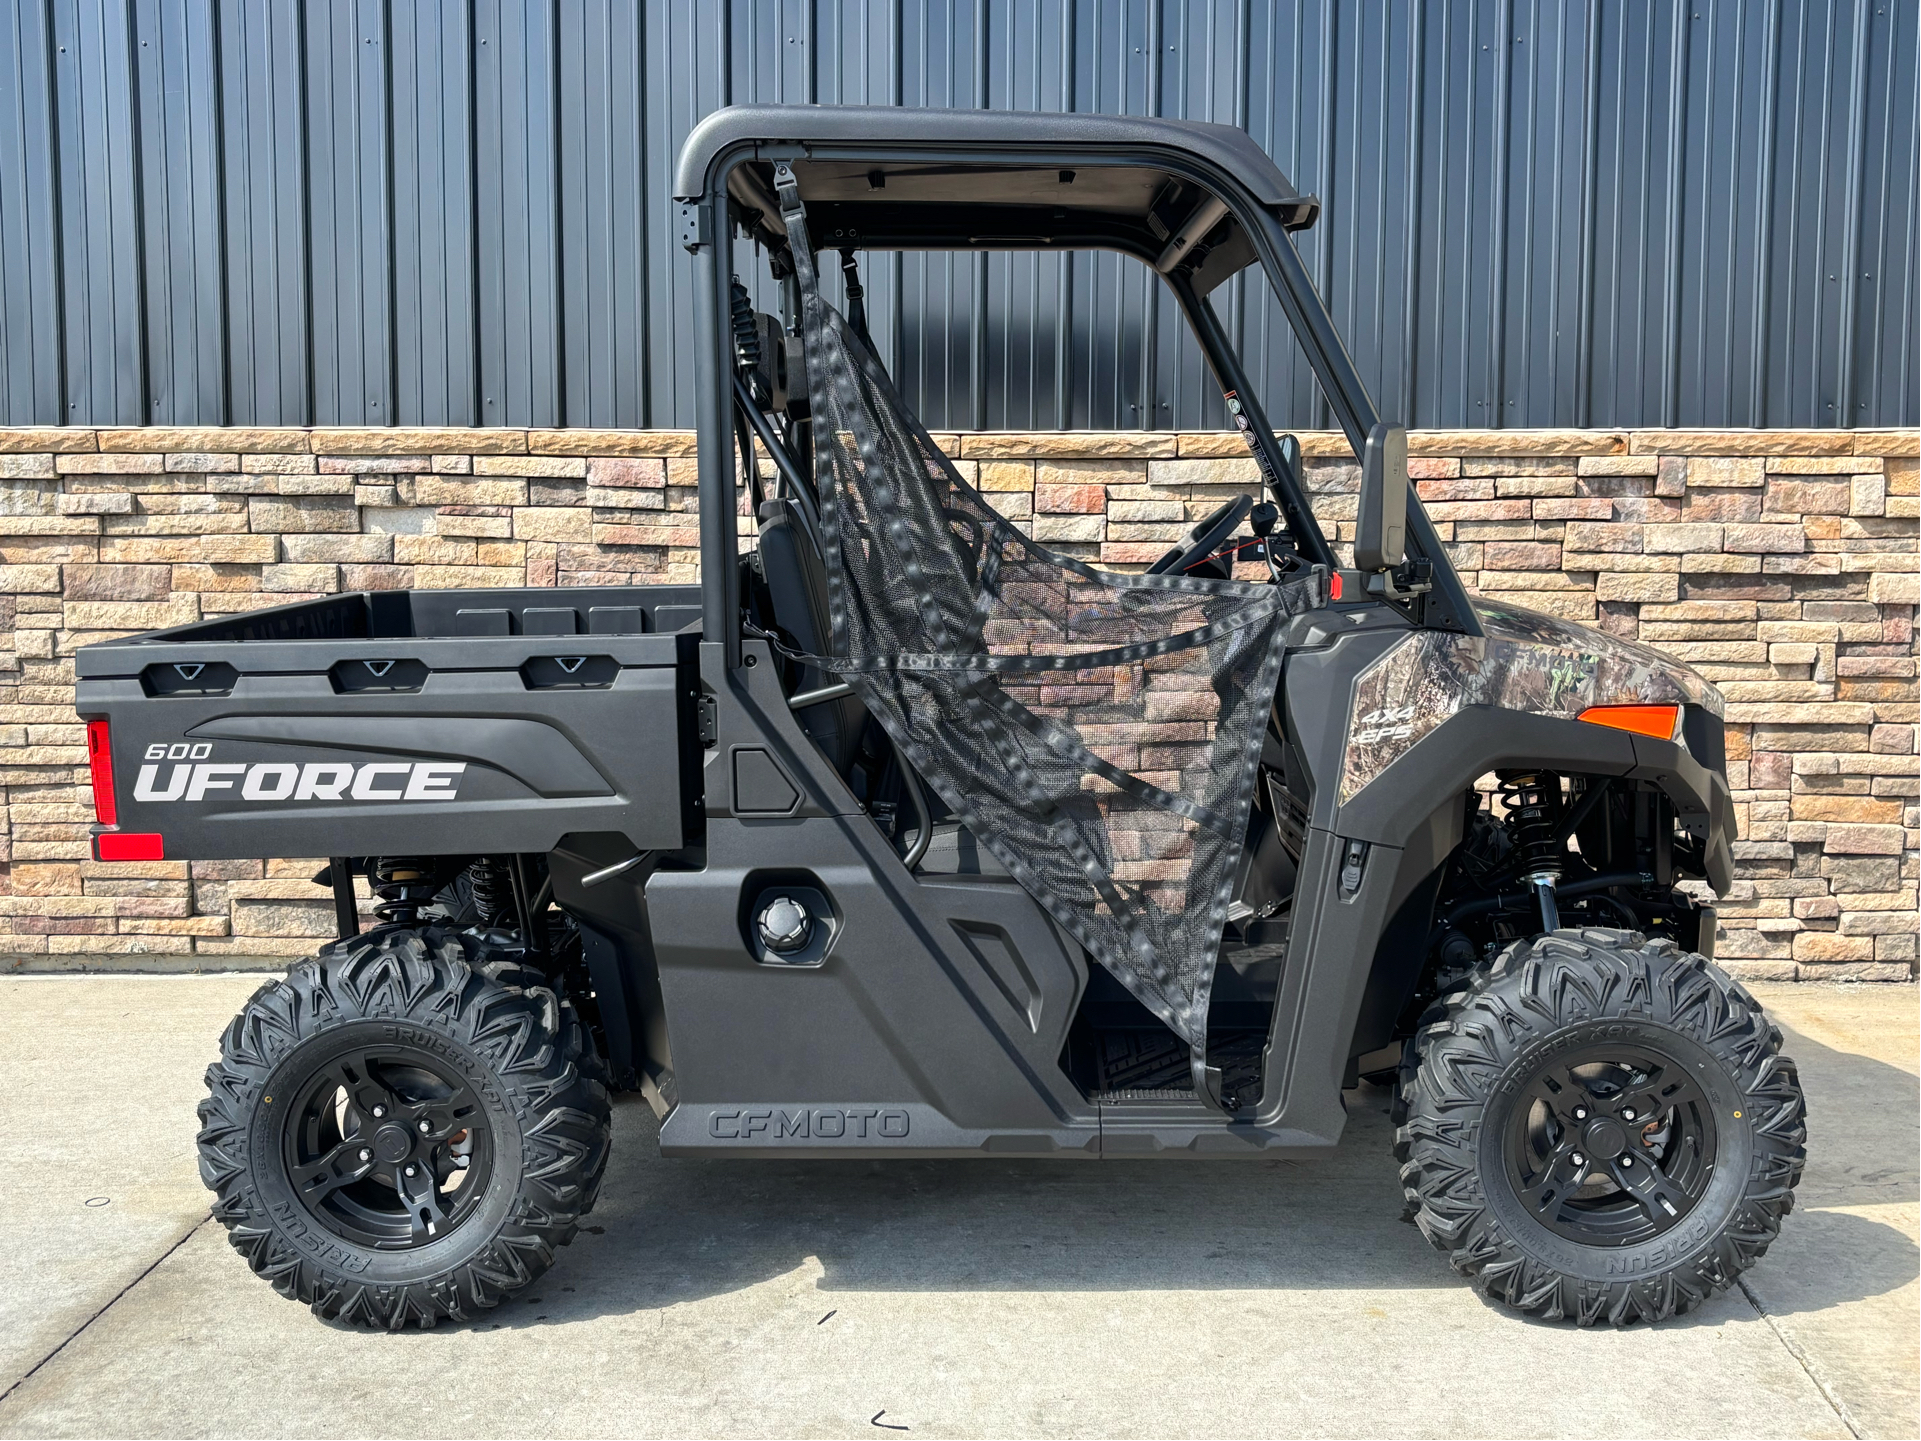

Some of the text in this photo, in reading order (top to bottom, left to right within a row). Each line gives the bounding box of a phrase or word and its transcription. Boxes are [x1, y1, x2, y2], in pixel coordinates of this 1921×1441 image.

[1495, 644, 1599, 677] CFMOTO
[1361, 705, 1415, 725] 4X4
[144, 743, 213, 760] 600
[1357, 724, 1414, 744] EPS
[133, 762, 467, 801] UFORCE
[382, 1025, 475, 1074] BRUISER
[1500, 1025, 1638, 1095] BRUISER XAT
[708, 1109, 910, 1138] CFMOTO
[273, 1201, 372, 1273] ARISUN
[1607, 1213, 1710, 1273] ARISUN
